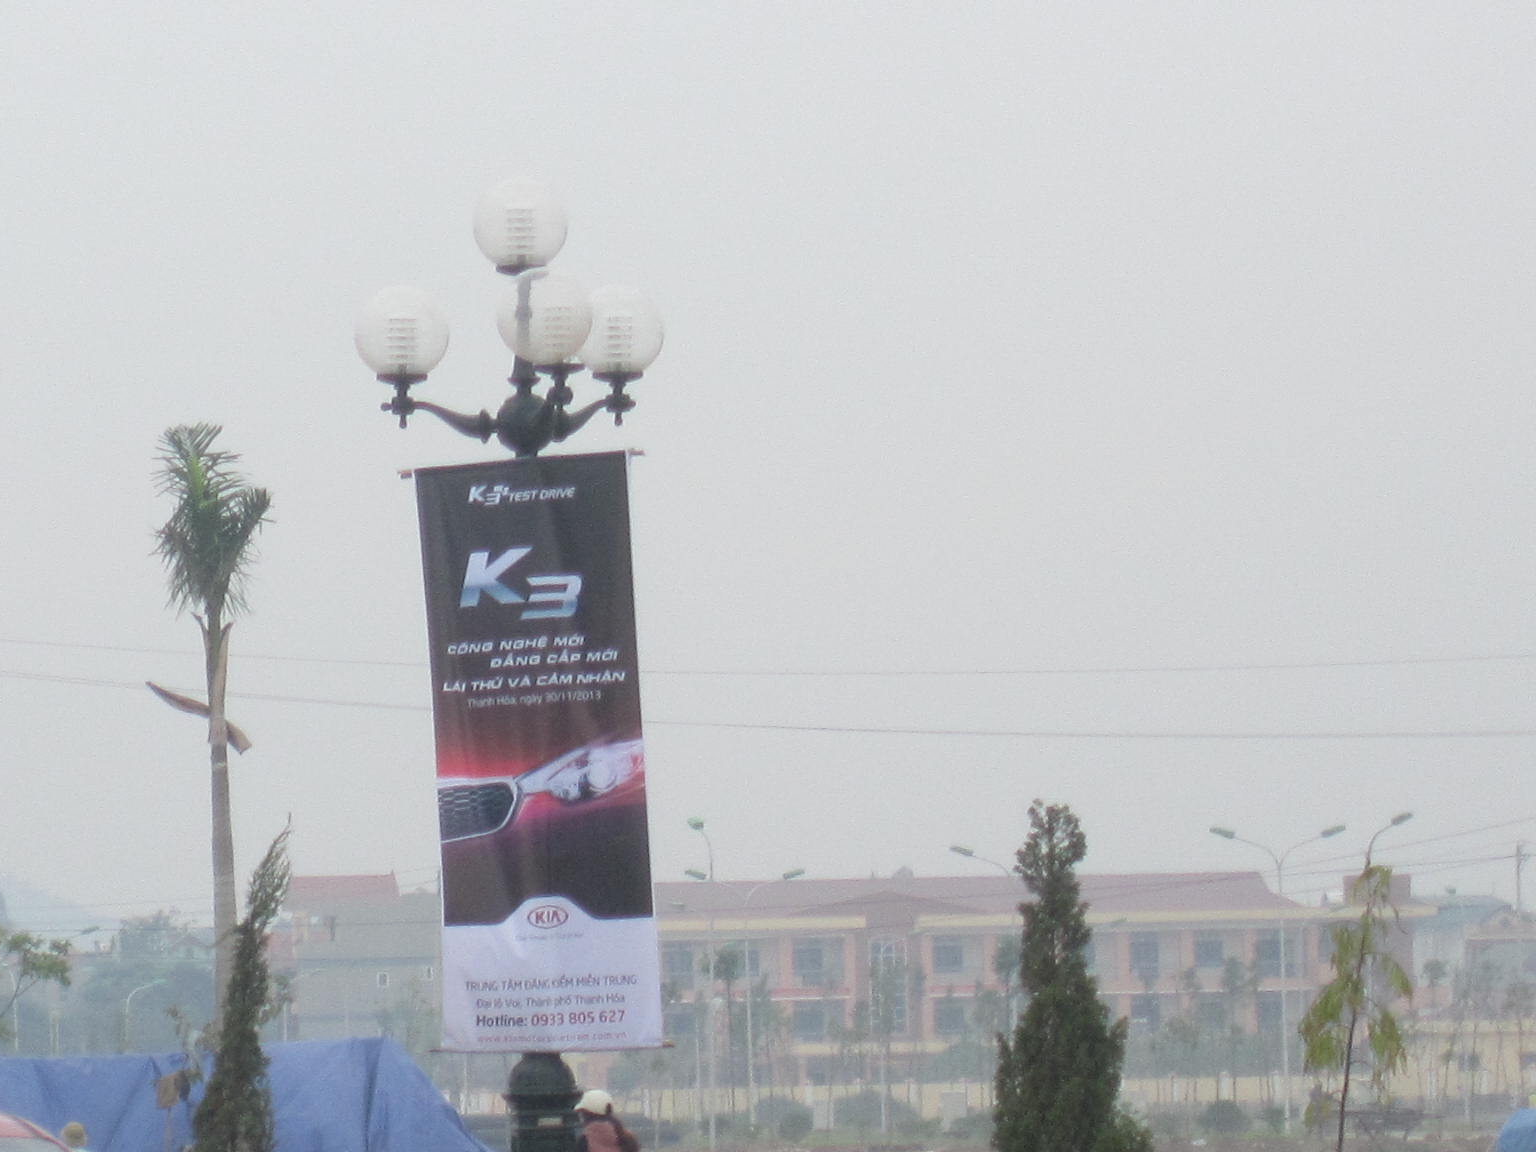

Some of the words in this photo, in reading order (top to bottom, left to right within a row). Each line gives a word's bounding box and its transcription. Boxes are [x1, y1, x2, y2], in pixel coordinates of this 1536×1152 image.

[509, 490, 539, 502] TEST
[539, 487, 576, 500] DRIVE
[459, 546, 582, 620] K3
[535, 910, 561, 925] KIA
[476, 1014, 528, 1028] Hotline:
[531, 1013, 564, 1027] 0933
[568, 1011, 595, 1025] 805
[599, 1009, 625, 1023] 627
